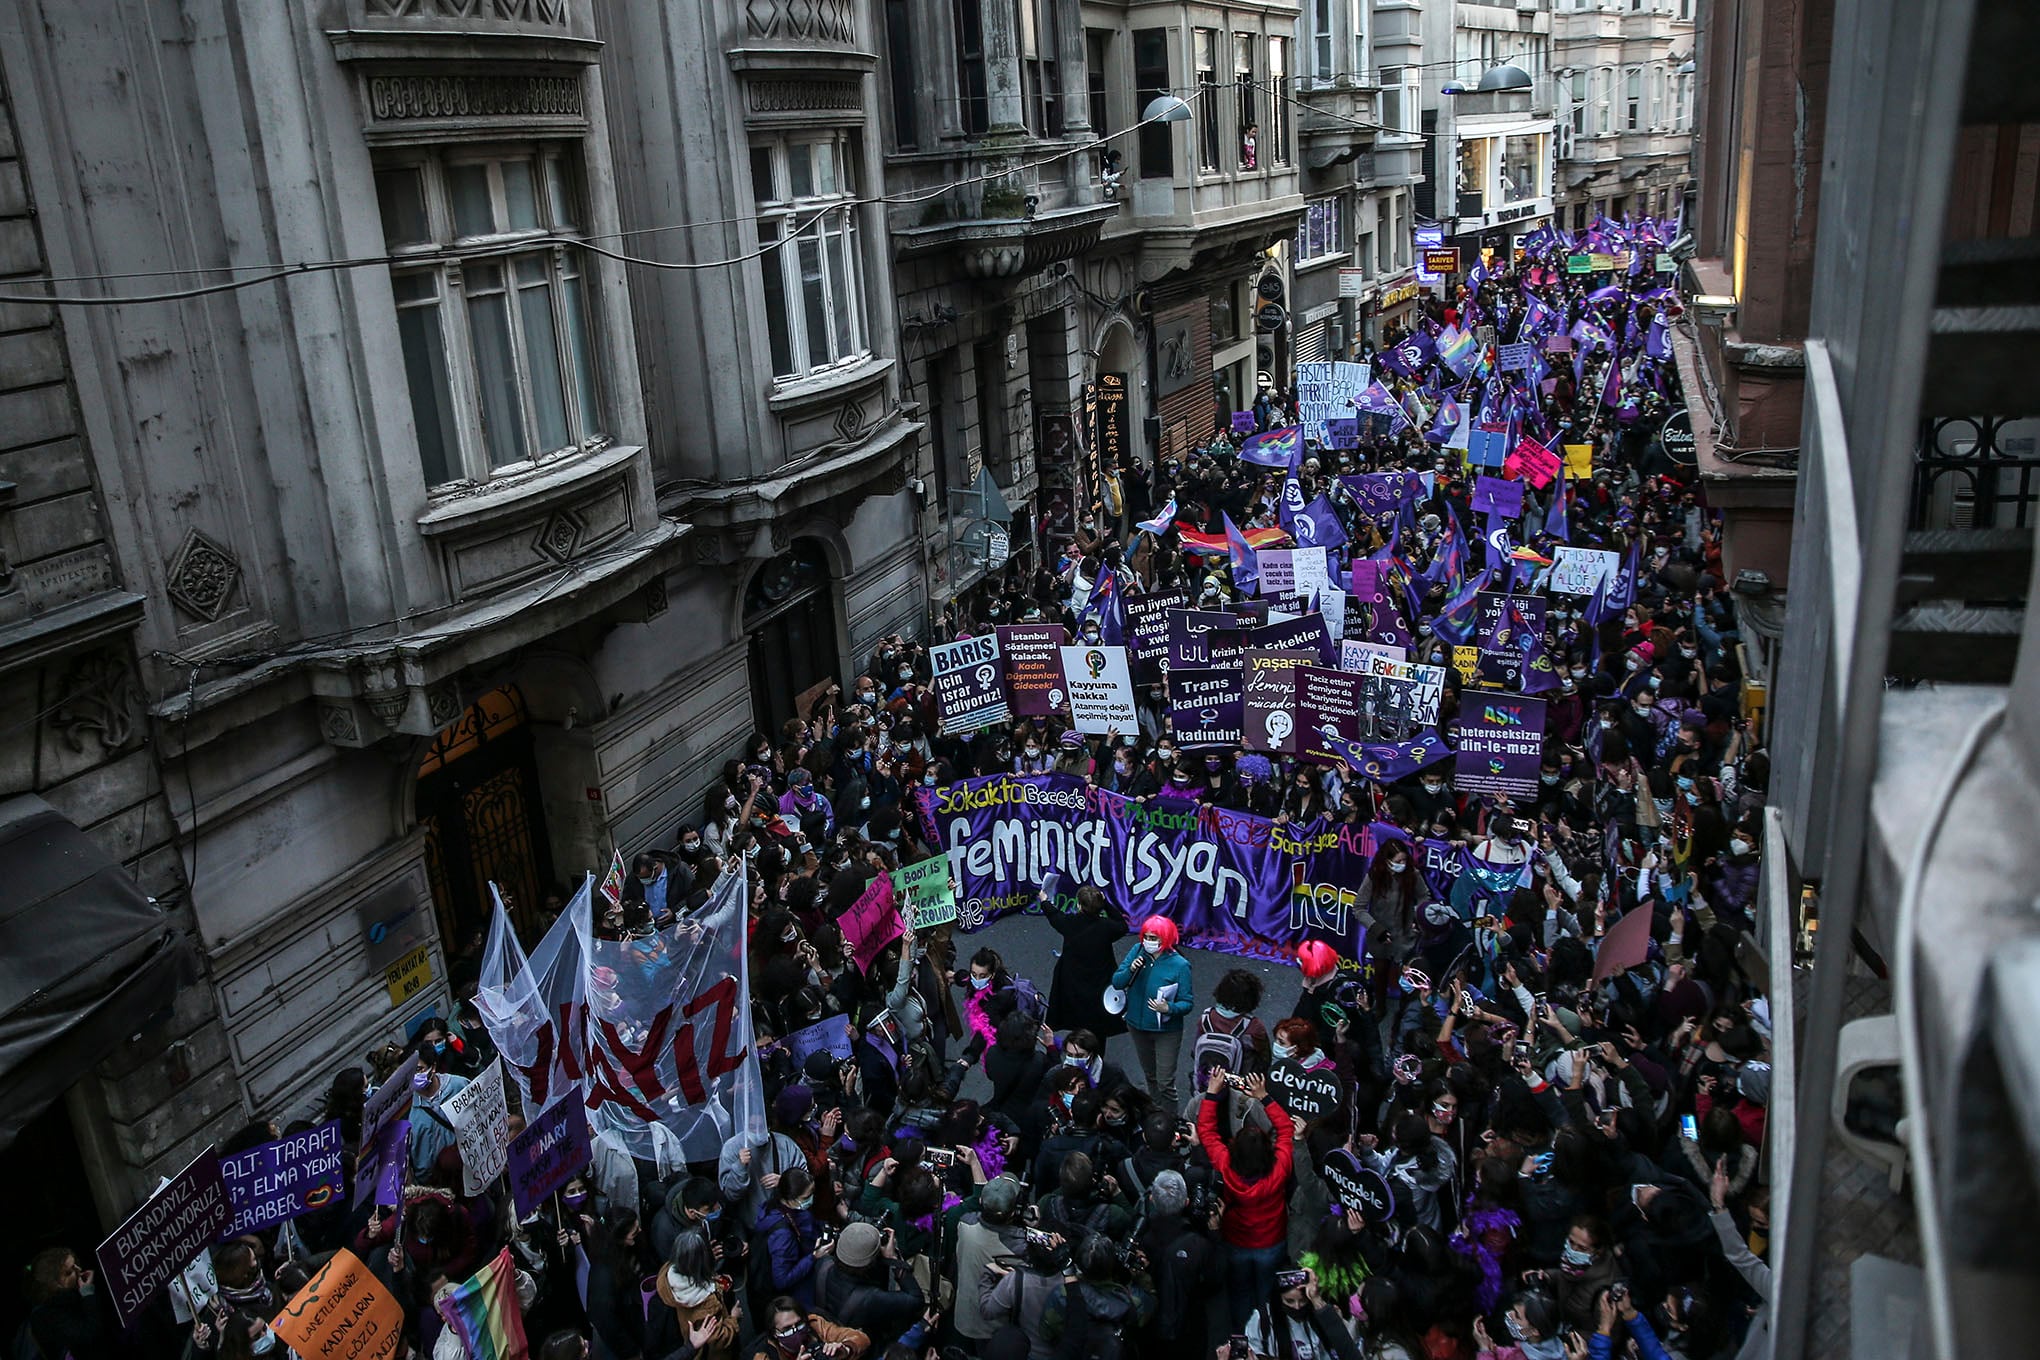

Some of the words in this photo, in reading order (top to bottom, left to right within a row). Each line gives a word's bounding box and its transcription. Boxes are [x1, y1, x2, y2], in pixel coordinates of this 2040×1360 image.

[1598, 552, 1606, 564] A
[1568, 586, 1591, 594] WOR
[1128, 603, 1146, 614] Em
[1147, 595, 1181, 612] jiyana
[1140, 612, 1162, 624] xwe
[1011, 631, 1050, 640] İstanbul
[1148, 634, 1170, 646] xwe
[1264, 628, 1321, 652] Erkekler
[934, 638, 995, 674] BARIŞ
[1004, 642, 1057, 652] Sözleşmesi
[1212, 648, 1236, 660] Krizin
[1011, 652, 1051, 662] Kalacak,
[1018, 662, 1045, 670] Kadın
[1344, 658, 1368, 670] REKT
[1006, 672, 1060, 682] Düşmanları
[1013, 682, 1054, 690] Gidecek!
[1070, 680, 1118, 692] Kayyuma
[1181, 678, 1230, 694] Trans
[942, 686, 971, 704] ısrar
[1308, 684, 1340, 695] demiyor
[1341, 689, 1352, 697] da
[945, 687, 1002, 716] ediyoruz!
[1074, 702, 1108, 712] Atanmış
[1109, 702, 1130, 713] değil
[1172, 692, 1240, 711] kadınlar
[1300, 700, 1316, 710] leke
[1076, 712, 1108, 722] seçilmiş
[1109, 713, 1134, 722] hayat!
[1319, 713, 1342, 723] diyor.
[1483, 705, 1522, 726] AŞK
[1176, 728, 1240, 742] kadındır!
[1460, 726, 1541, 741] heteroseksizm
[1460, 739, 1540, 756] din-le-mez!
[936, 778, 1024, 814] Sokakta
[904, 865, 927, 884] BODY
[930, 861, 940, 874] IS
[948, 816, 1112, 899] feminist
[1125, 827, 1250, 920] isyan
[401, 954, 418, 977] HAYAT
[1270, 1066, 1338, 1104] devrim
[452, 1082, 482, 1114] BABAMI
[1288, 1092, 1320, 1114] için
[550, 1100, 569, 1126] THE
[528, 1118, 569, 1163] BINARY
[556, 1136, 574, 1158] THE
[222, 1152, 260, 1180] ALT
[269, 1126, 336, 1166] TARAFI
[254, 1166, 299, 1196] ELMA
[302, 1150, 342, 1178] YEDİK
[1324, 1164, 1384, 1210] mücadele
[116, 1176, 197, 1260] BURADAYIZ!
[223, 1192, 302, 1238] BERABER
[120, 1181, 222, 1286] KORKMUYORUZ!
[124, 1217, 216, 1314] SUSMUYORUZ!
[320, 1292, 376, 1357] KADINLARIN
[346, 1321, 378, 1360] GÖZÜ
